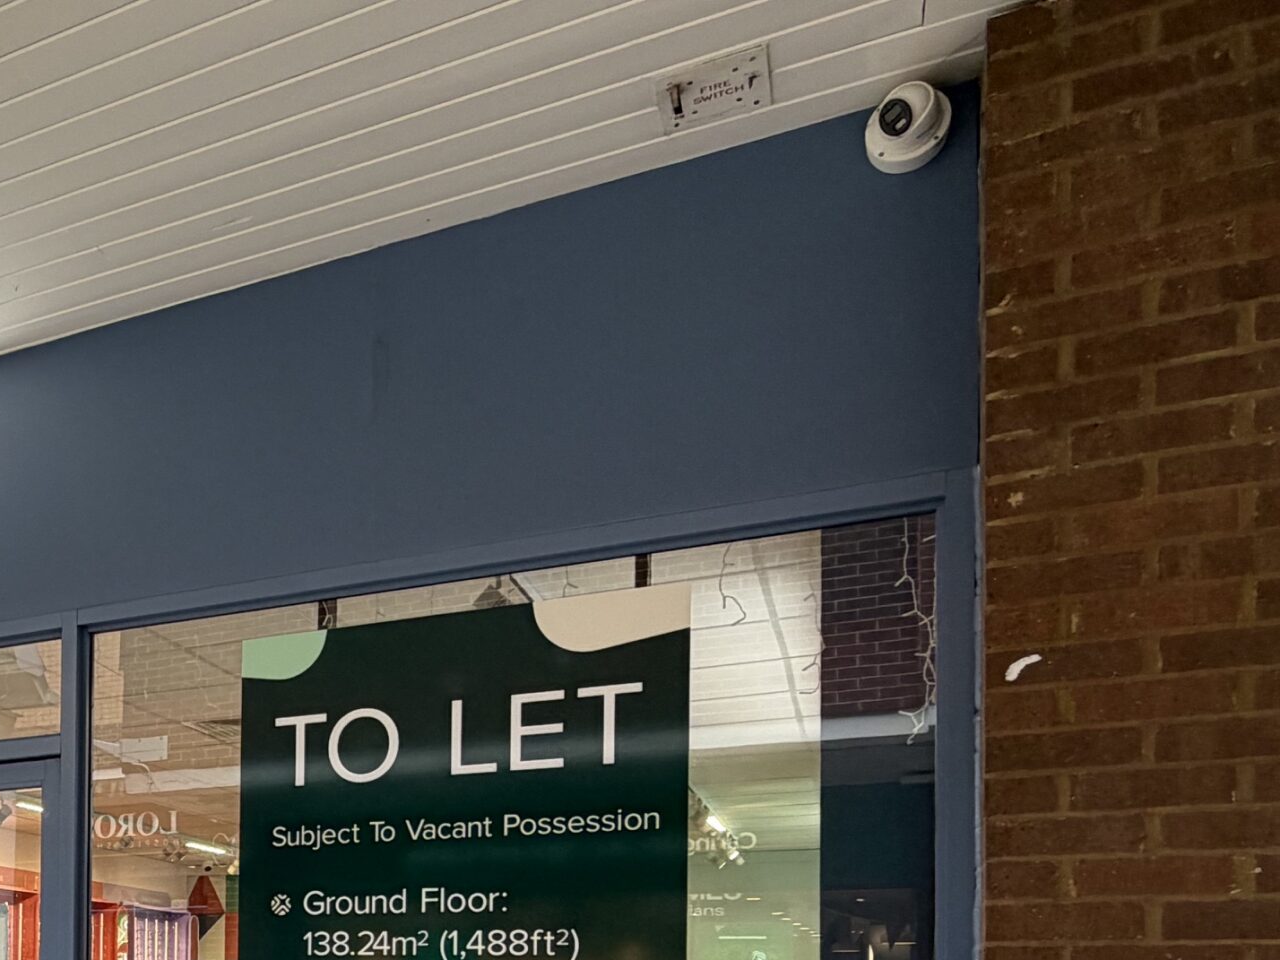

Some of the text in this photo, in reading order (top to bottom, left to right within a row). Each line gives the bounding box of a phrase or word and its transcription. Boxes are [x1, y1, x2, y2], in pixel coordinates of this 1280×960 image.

[693, 84, 744, 105] SWITCH
[700, 79, 732, 94] FIRE
[274, 681, 643, 787] TO LET
[272, 808, 661, 850] Subject To Vacant Possession
[302, 886, 508, 916] Ground Floor:
[302, 929, 429, 957] 138.24m²
